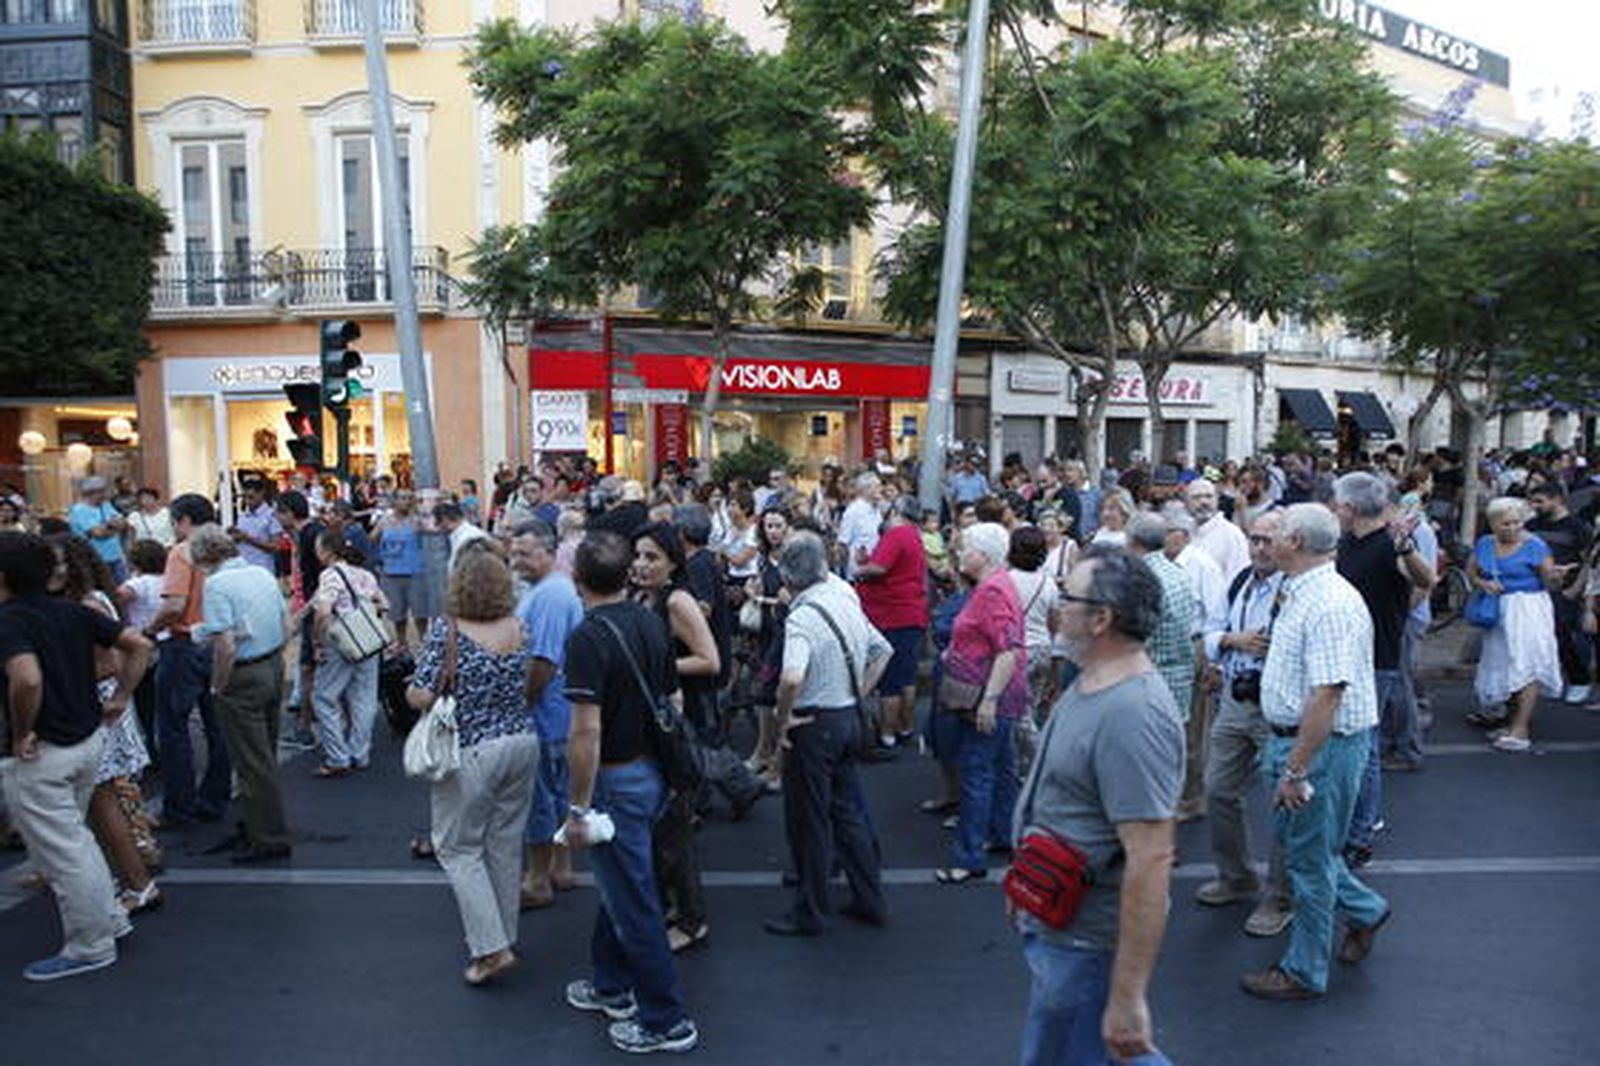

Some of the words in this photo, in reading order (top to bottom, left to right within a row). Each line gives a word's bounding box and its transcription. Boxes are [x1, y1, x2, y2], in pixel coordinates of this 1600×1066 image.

[1402, 22, 1479, 71] ARCOS
[722, 365, 842, 390] VISIONLAB
[1110, 377, 1203, 401] SEURA
